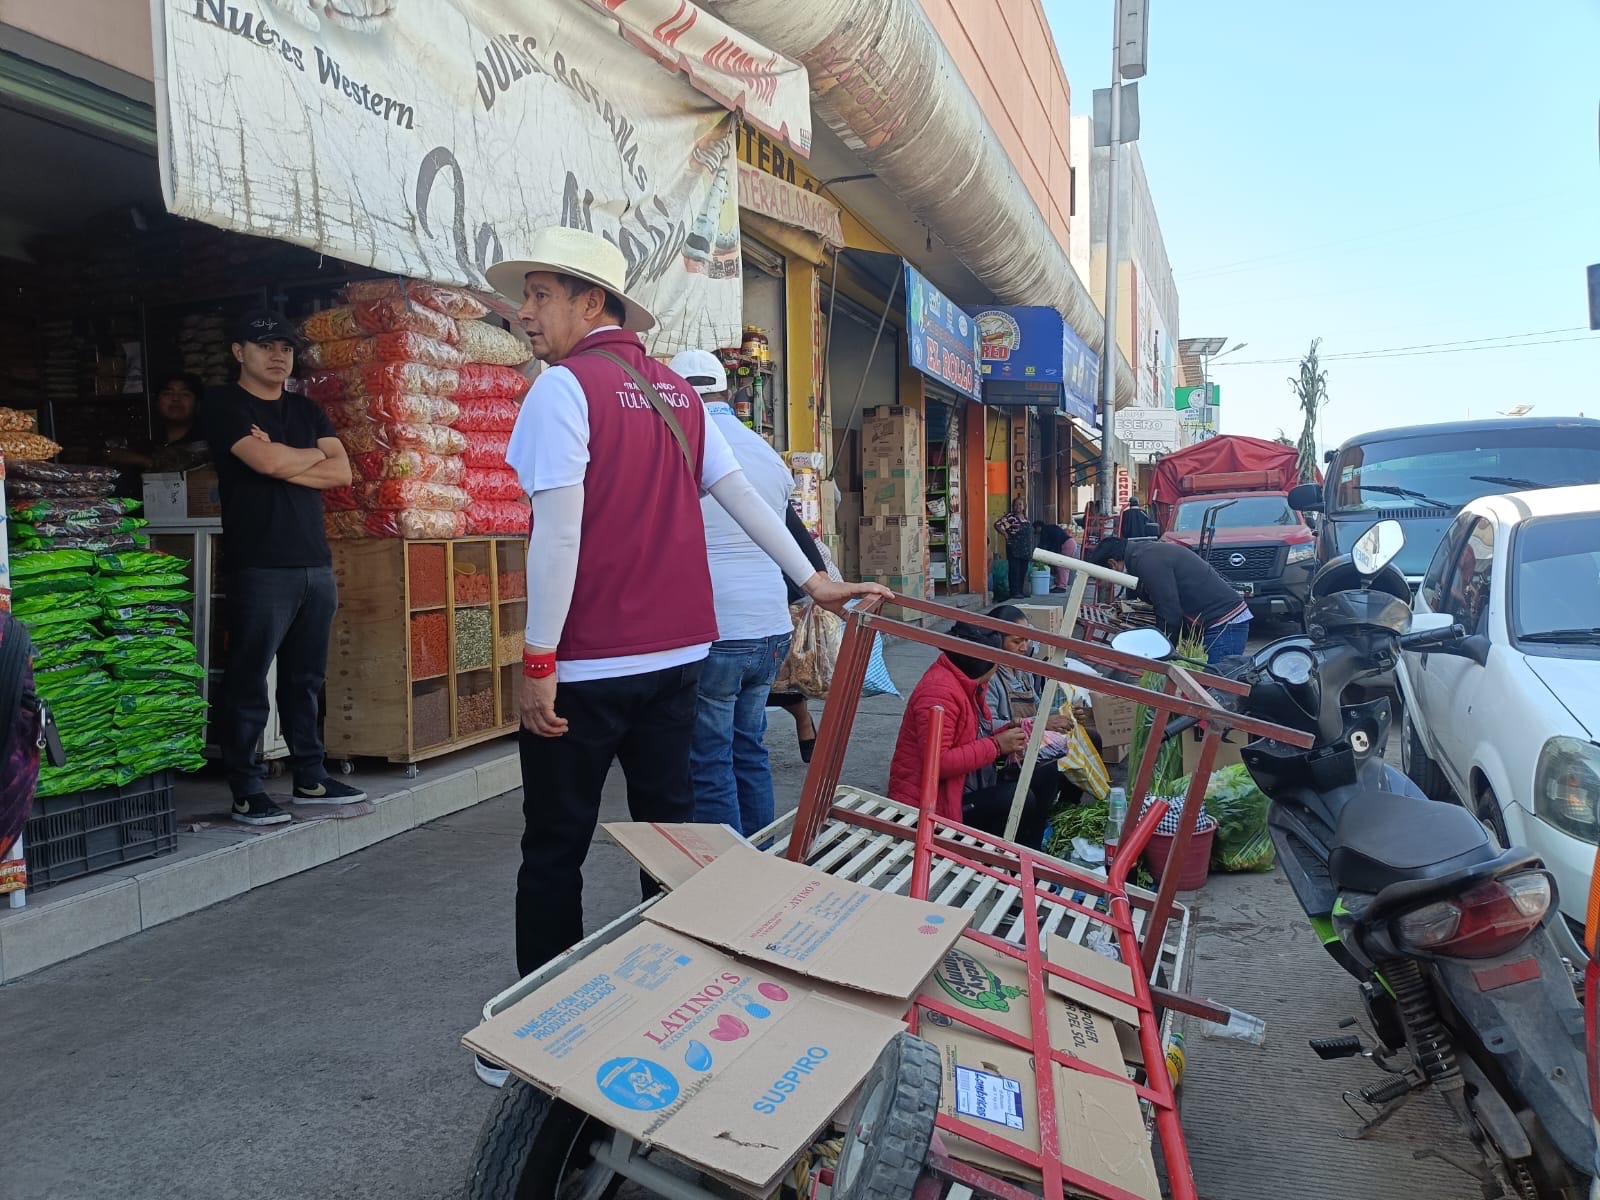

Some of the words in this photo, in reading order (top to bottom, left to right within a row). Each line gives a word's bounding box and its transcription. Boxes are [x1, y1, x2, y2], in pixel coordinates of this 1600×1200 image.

[313, 46, 414, 130] Western
[476, 34, 545, 111] DULCES
[553, 51, 648, 193] BOTANAS
[739, 168, 781, 214] TERA
[926, 336, 941, 375] EL
[942, 347, 973, 394] ROLLO
[615, 389, 690, 409] TULANGO
[962, 955, 986, 991] Lucky
[512, 1006, 561, 1039] MANEJESE
[556, 995, 578, 1011] CON
[573, 973, 611, 998] CUIDADO
[532, 1008, 580, 1040] PRODUCTO
[575, 983, 617, 1012] DELICADO
[1069, 1010, 1082, 1031] DEL
[1077, 1003, 1100, 1044] PONER
[1072, 1030, 1087, 1049] SOL
[752, 1046, 829, 1116] SUSPIRO
